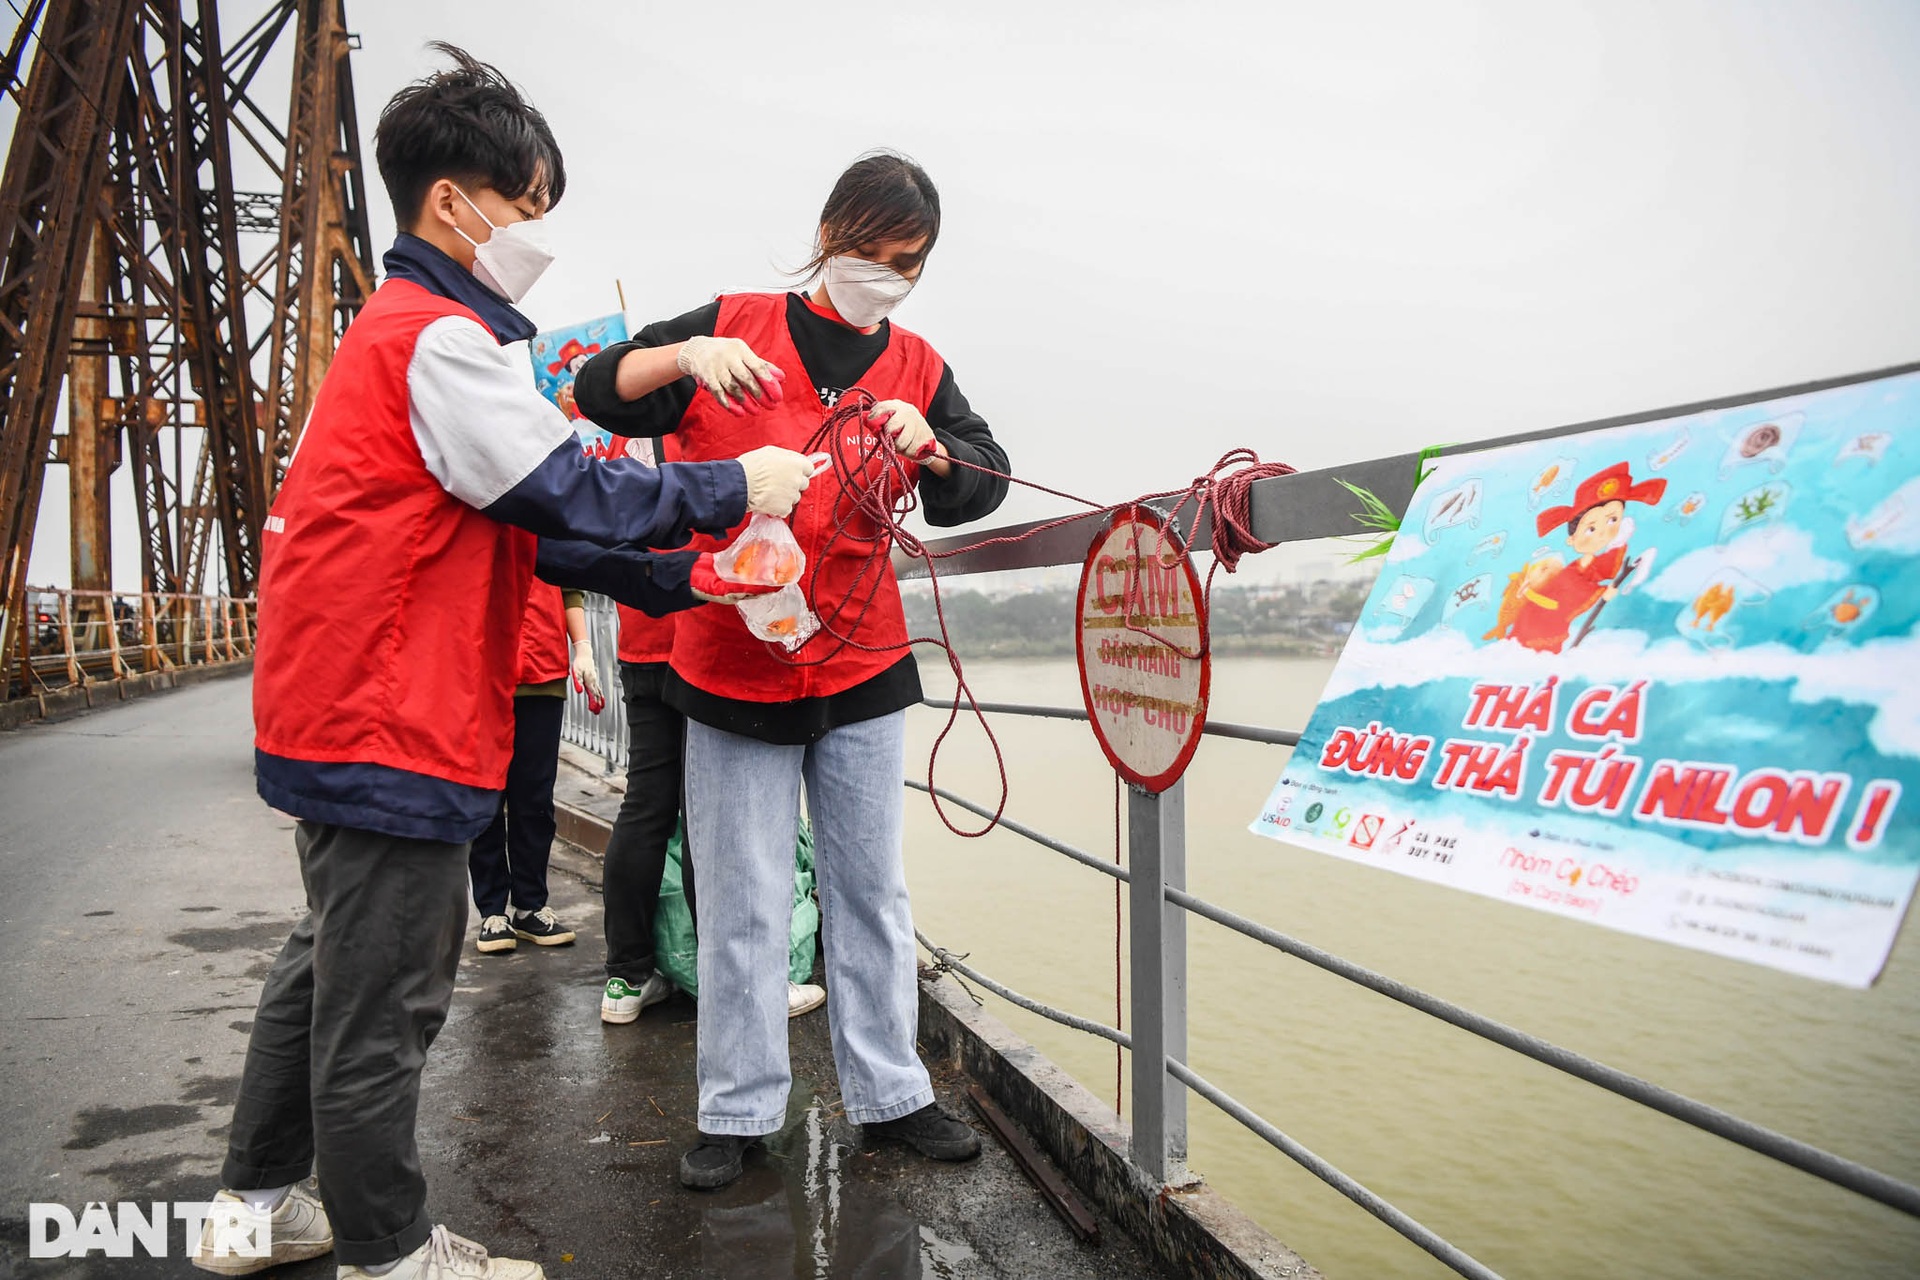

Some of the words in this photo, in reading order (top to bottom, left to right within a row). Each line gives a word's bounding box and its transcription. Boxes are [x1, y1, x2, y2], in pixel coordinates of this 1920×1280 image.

[1101, 633, 1133, 669] BÁN
[1137, 639, 1181, 679] HÀNG
[1466, 675, 1559, 732] THẢ
[1570, 680, 1648, 739] CÁ
[1322, 725, 1430, 780] ĐỪNG
[1436, 737, 1529, 796] THẢ
[1543, 749, 1635, 810] TÚI
[1640, 765, 1842, 837] NILON
[1856, 787, 1892, 843] !
[1262, 812, 1291, 828] USAID
